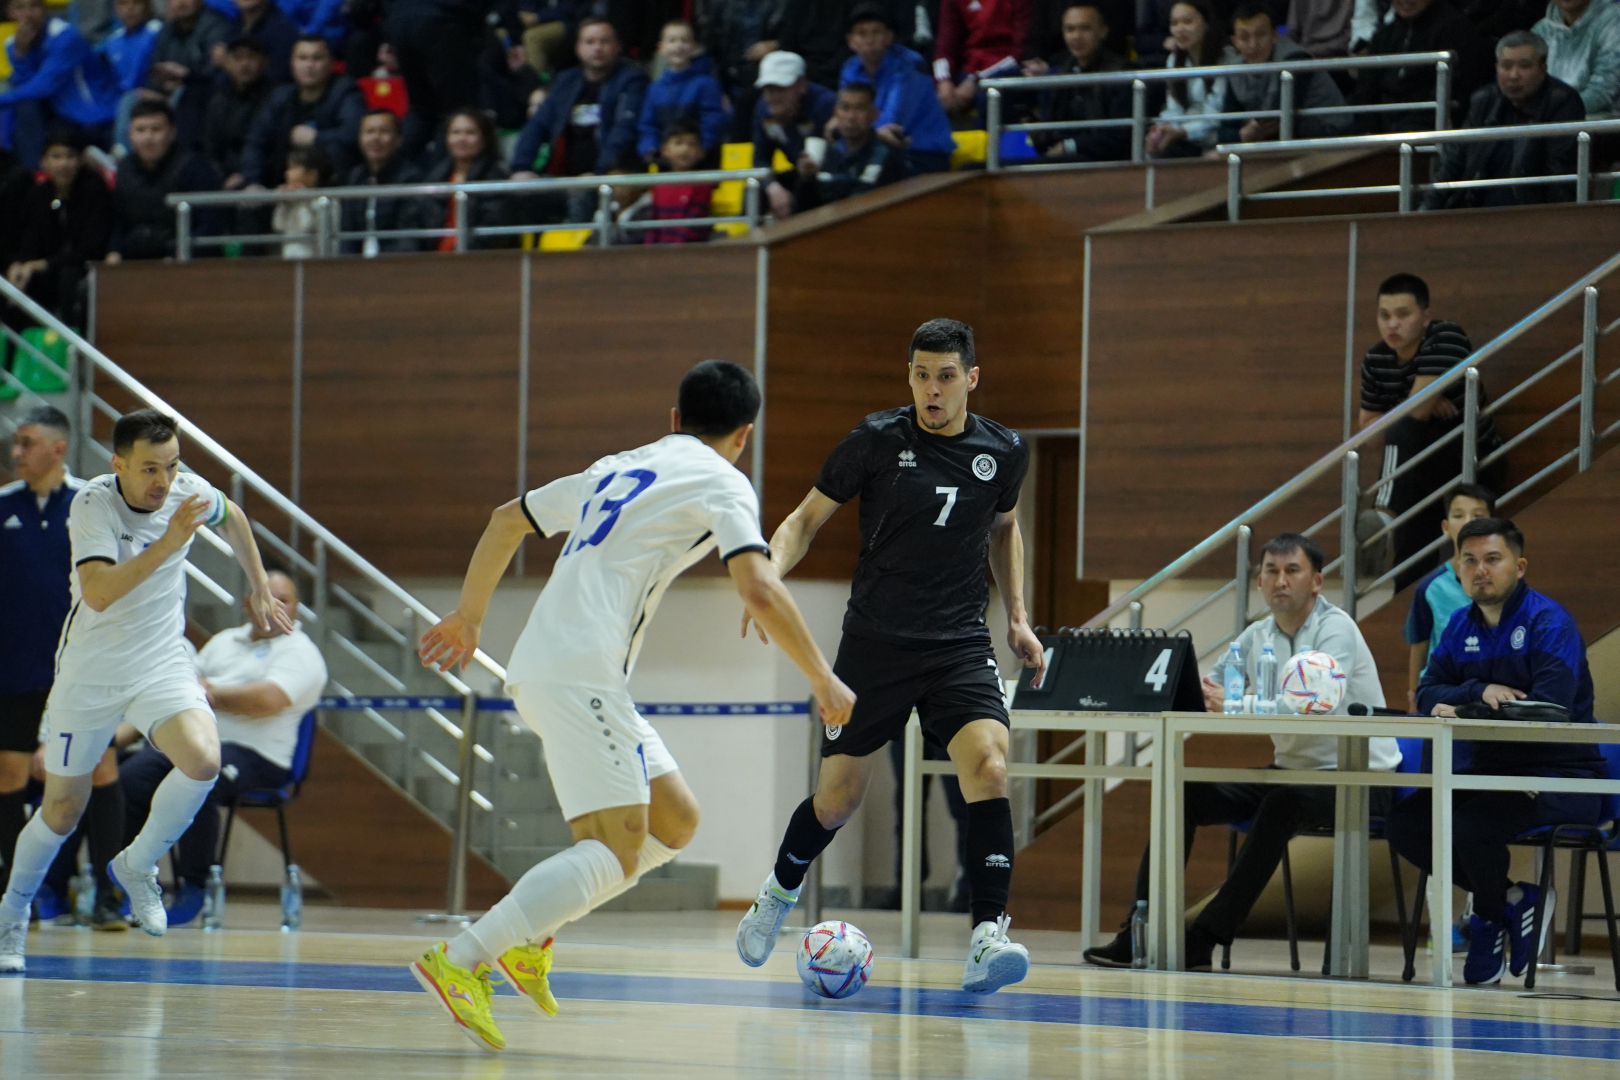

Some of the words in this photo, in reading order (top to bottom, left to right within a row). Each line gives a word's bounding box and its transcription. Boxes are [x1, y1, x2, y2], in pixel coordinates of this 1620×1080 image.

[933, 486, 959, 527] 7
[1144, 648, 1173, 692] 4
[59, 732, 73, 766] 7
